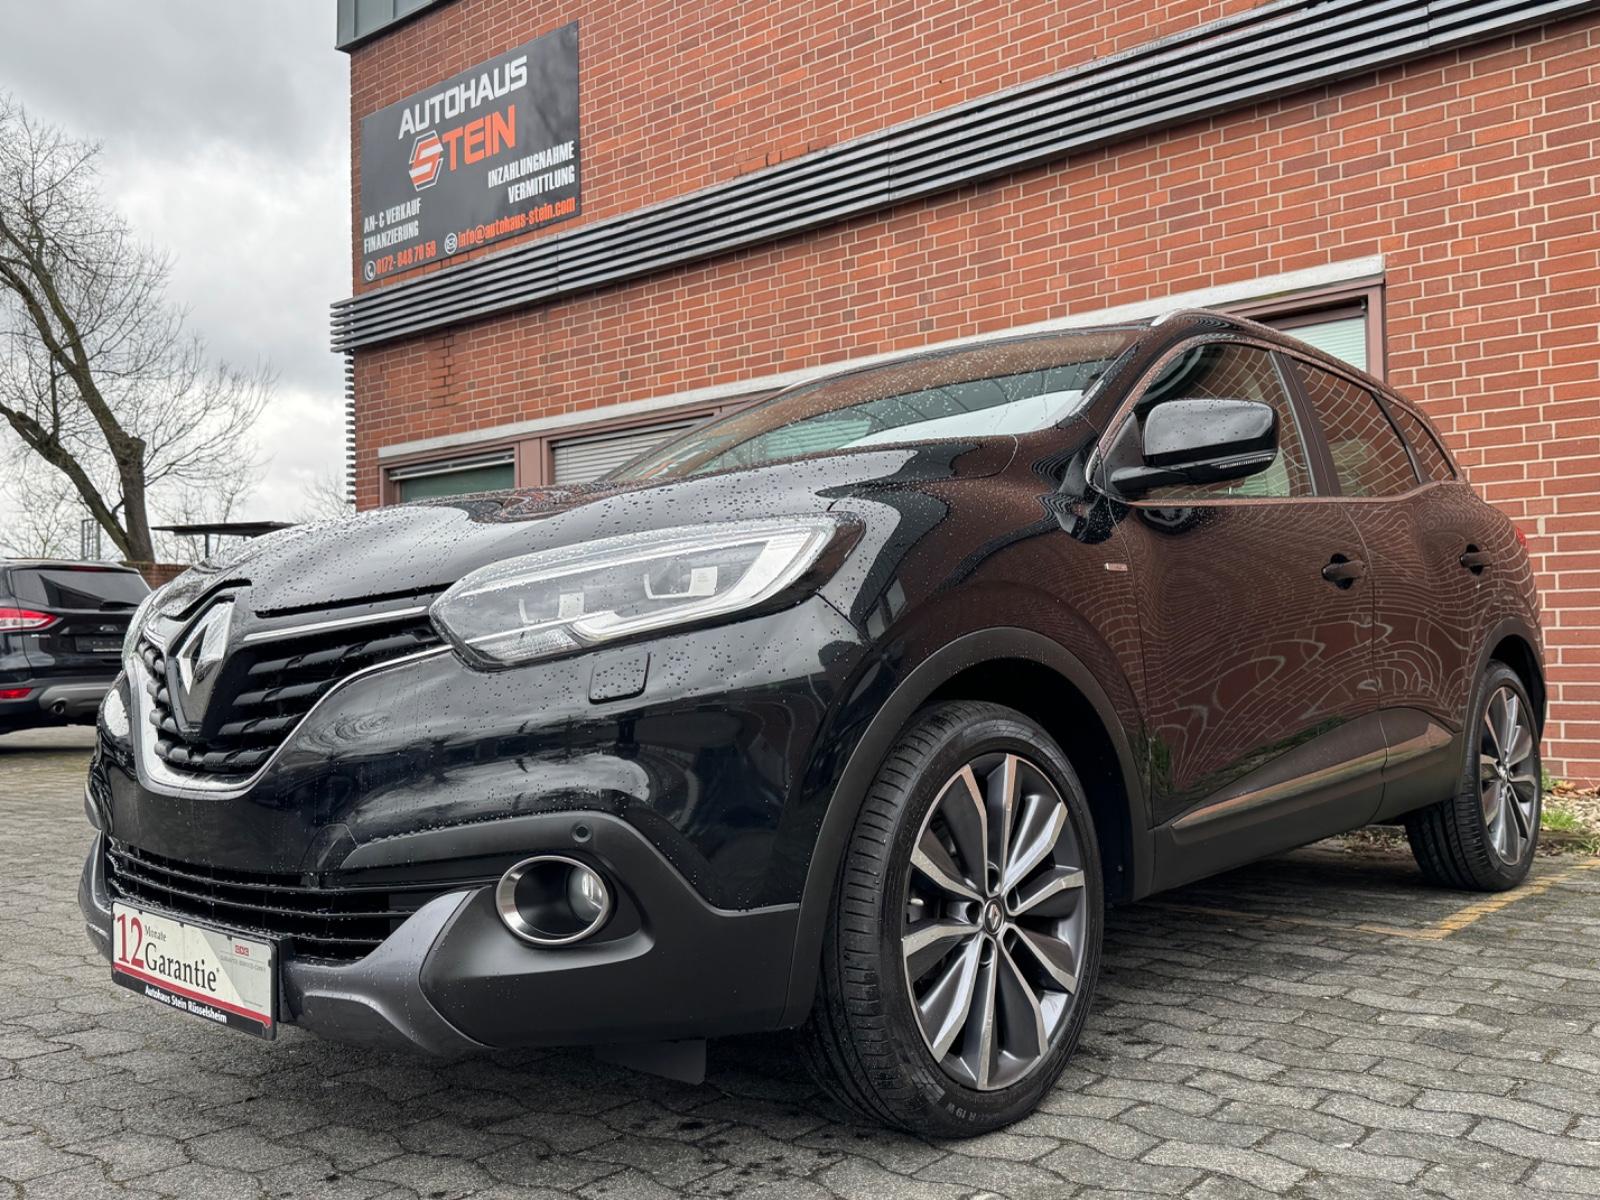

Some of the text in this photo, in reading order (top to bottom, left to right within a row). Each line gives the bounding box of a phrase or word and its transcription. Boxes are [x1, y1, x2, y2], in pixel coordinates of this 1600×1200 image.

[398, 55, 528, 140] AUTOHAUS
[409, 103, 517, 192] STEIN
[487, 140, 576, 189] INZAHLUNGNAHME
[507, 164, 576, 205] VERMITTLUNG
[385, 197, 421, 226] VERKAUF
[457, 197, 576, 248] info@autohaus-stein.com
[363, 220, 419, 255] FINANZIERUNG
[116, 913, 145, 970] 12
[144, 924, 167, 942] Monate
[145, 942, 218, 993] Garantie
[145, 984, 171, 1004] Autohaus
[171, 994, 187, 1010] Stein
[187, 1000, 228, 1025] Rüsselsheim
